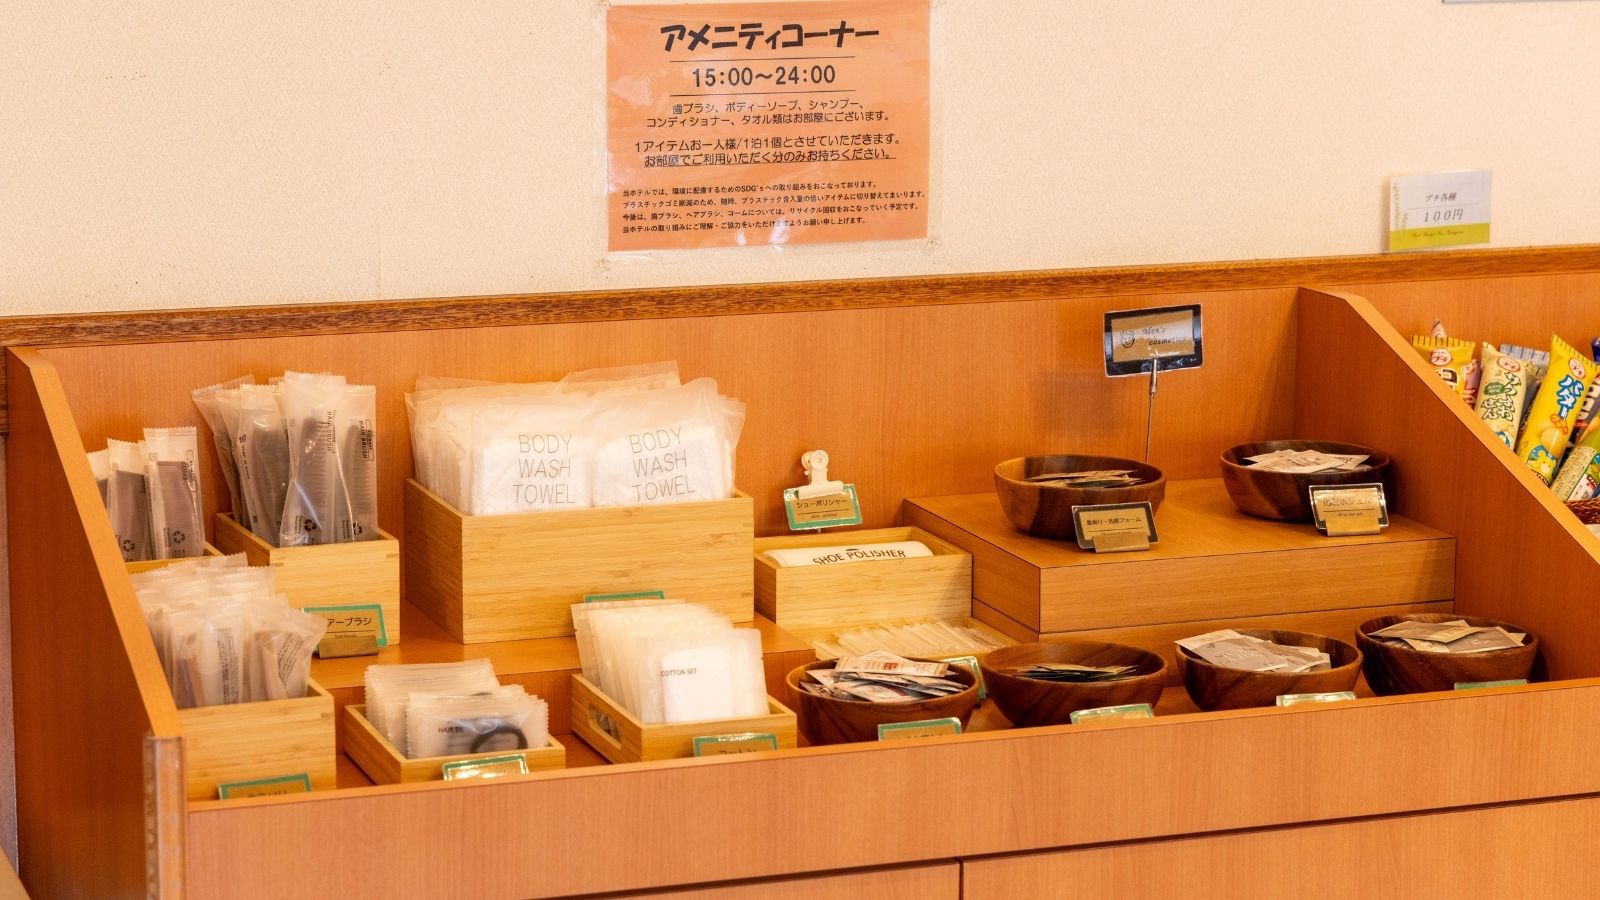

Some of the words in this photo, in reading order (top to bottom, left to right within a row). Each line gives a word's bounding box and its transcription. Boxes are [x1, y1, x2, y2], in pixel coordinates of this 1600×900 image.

[660, 20, 880, 52] アメニティコーナー
[692, 65, 836, 88] 15:00～24:00
[672, 98, 865, 115] 歯ブラシ、ボディーソープ、シャンプー、
[646, 110, 890, 128] コンディショナー、タオル類はお部屋にございます。
[634, 133, 901, 153] 1アイテムお一人様/1泊1個とさせていただきます。
[644, 148, 892, 167] お部屋でご利用いただく分のみお持ちください。
[1556, 374, 1584, 419] バター
[360, 437, 368, 459] BRUSH
[518, 433, 573, 455] BODY
[628, 426, 683, 455] BODY
[517, 457, 572, 479] WASH
[632, 449, 688, 478] WASH
[512, 483, 577, 505] TOWEL
[631, 474, 696, 502] TOWEL
[796, 499, 848, 509] シューポリシャー
[813, 553, 845, 565] SHOE
[846, 549, 907, 560] POLISHER
[327, 617, 372, 628] アーブラシ
[660, 669, 686, 677] COTTON
